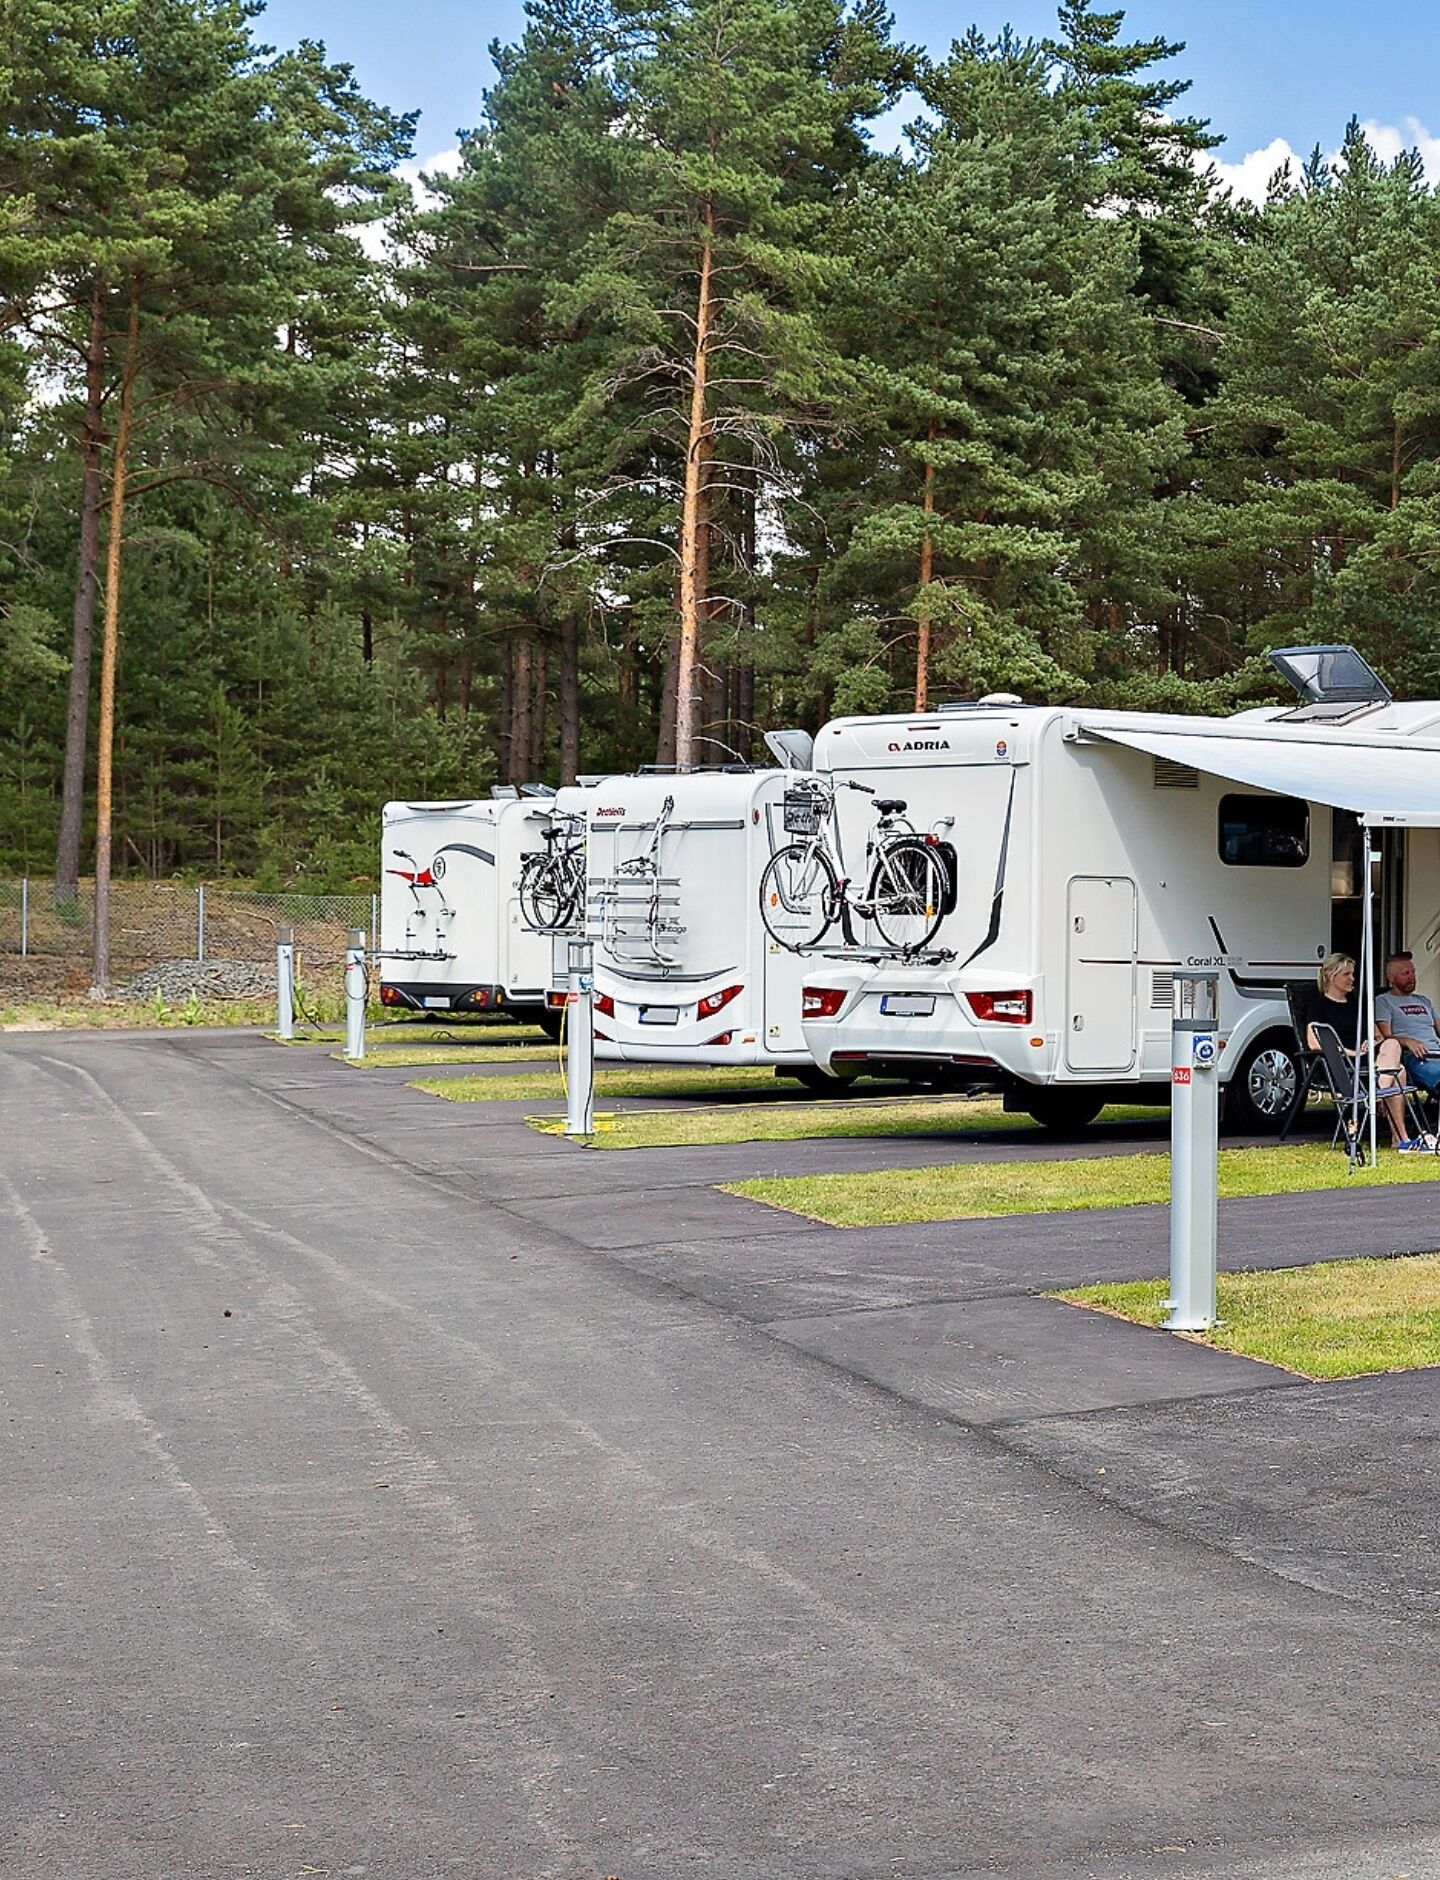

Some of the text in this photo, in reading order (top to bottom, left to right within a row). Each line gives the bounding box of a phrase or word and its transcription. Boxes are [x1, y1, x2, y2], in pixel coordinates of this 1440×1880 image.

[903, 740, 950, 751] ADRIA
[1187, 955, 1212, 966] Coral
[1213, 957, 1226, 966] XL
